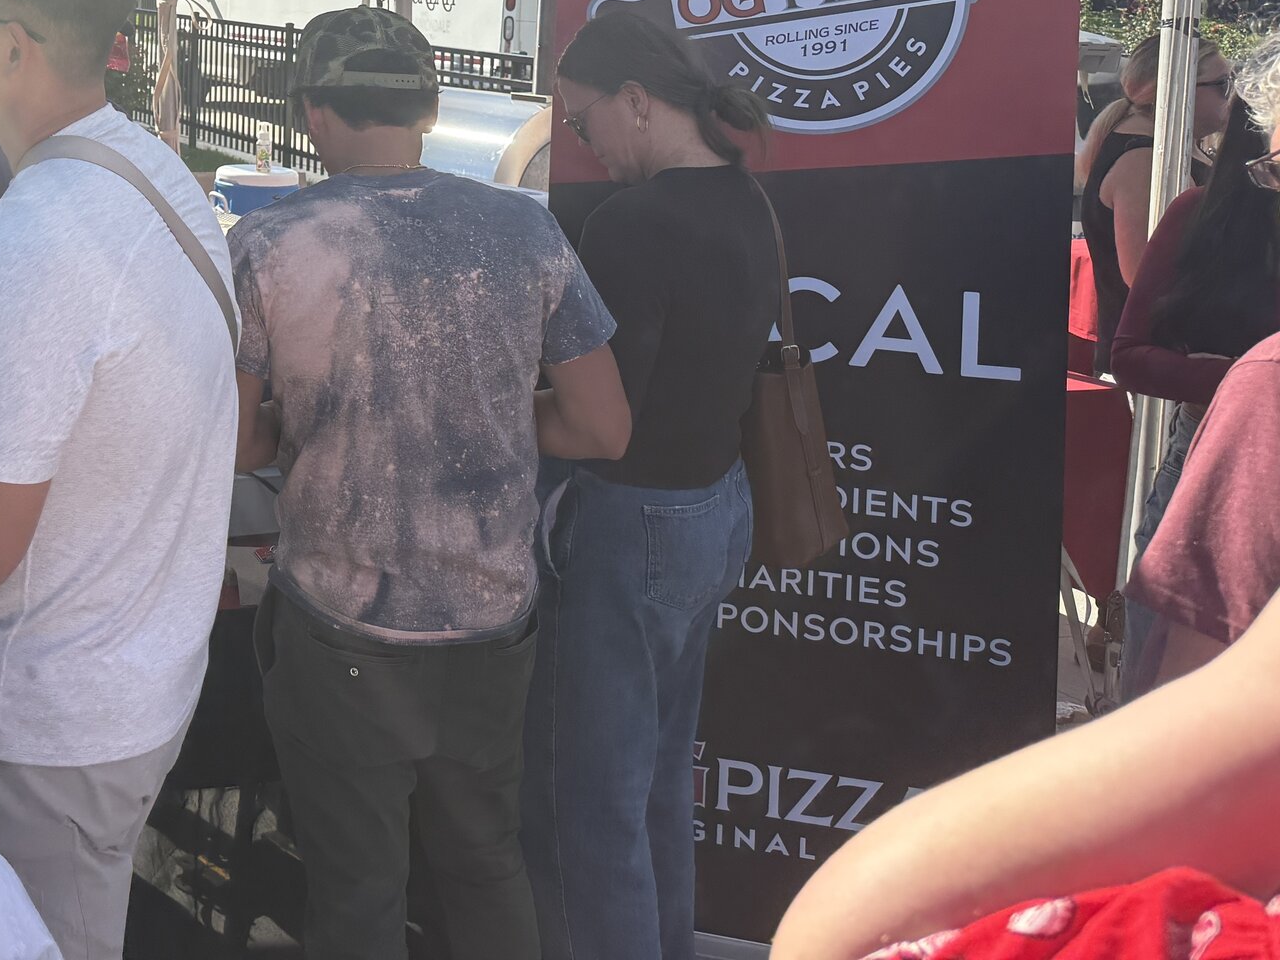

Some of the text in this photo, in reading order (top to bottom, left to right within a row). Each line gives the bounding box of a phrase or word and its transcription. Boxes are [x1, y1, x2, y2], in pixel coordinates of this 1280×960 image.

[765, 18, 880, 47] ROLLING SINCE
[800, 39, 849, 58] 1991
[728, 37, 927, 109] PIZZA PIES
[827, 441, 872, 471] RS
[838, 532, 940, 568] IONS
[739, 564, 907, 608] ARITIES
[717, 602, 1013, 667] PONSORSHIPS
[715, 757, 927, 831] PIZZ
